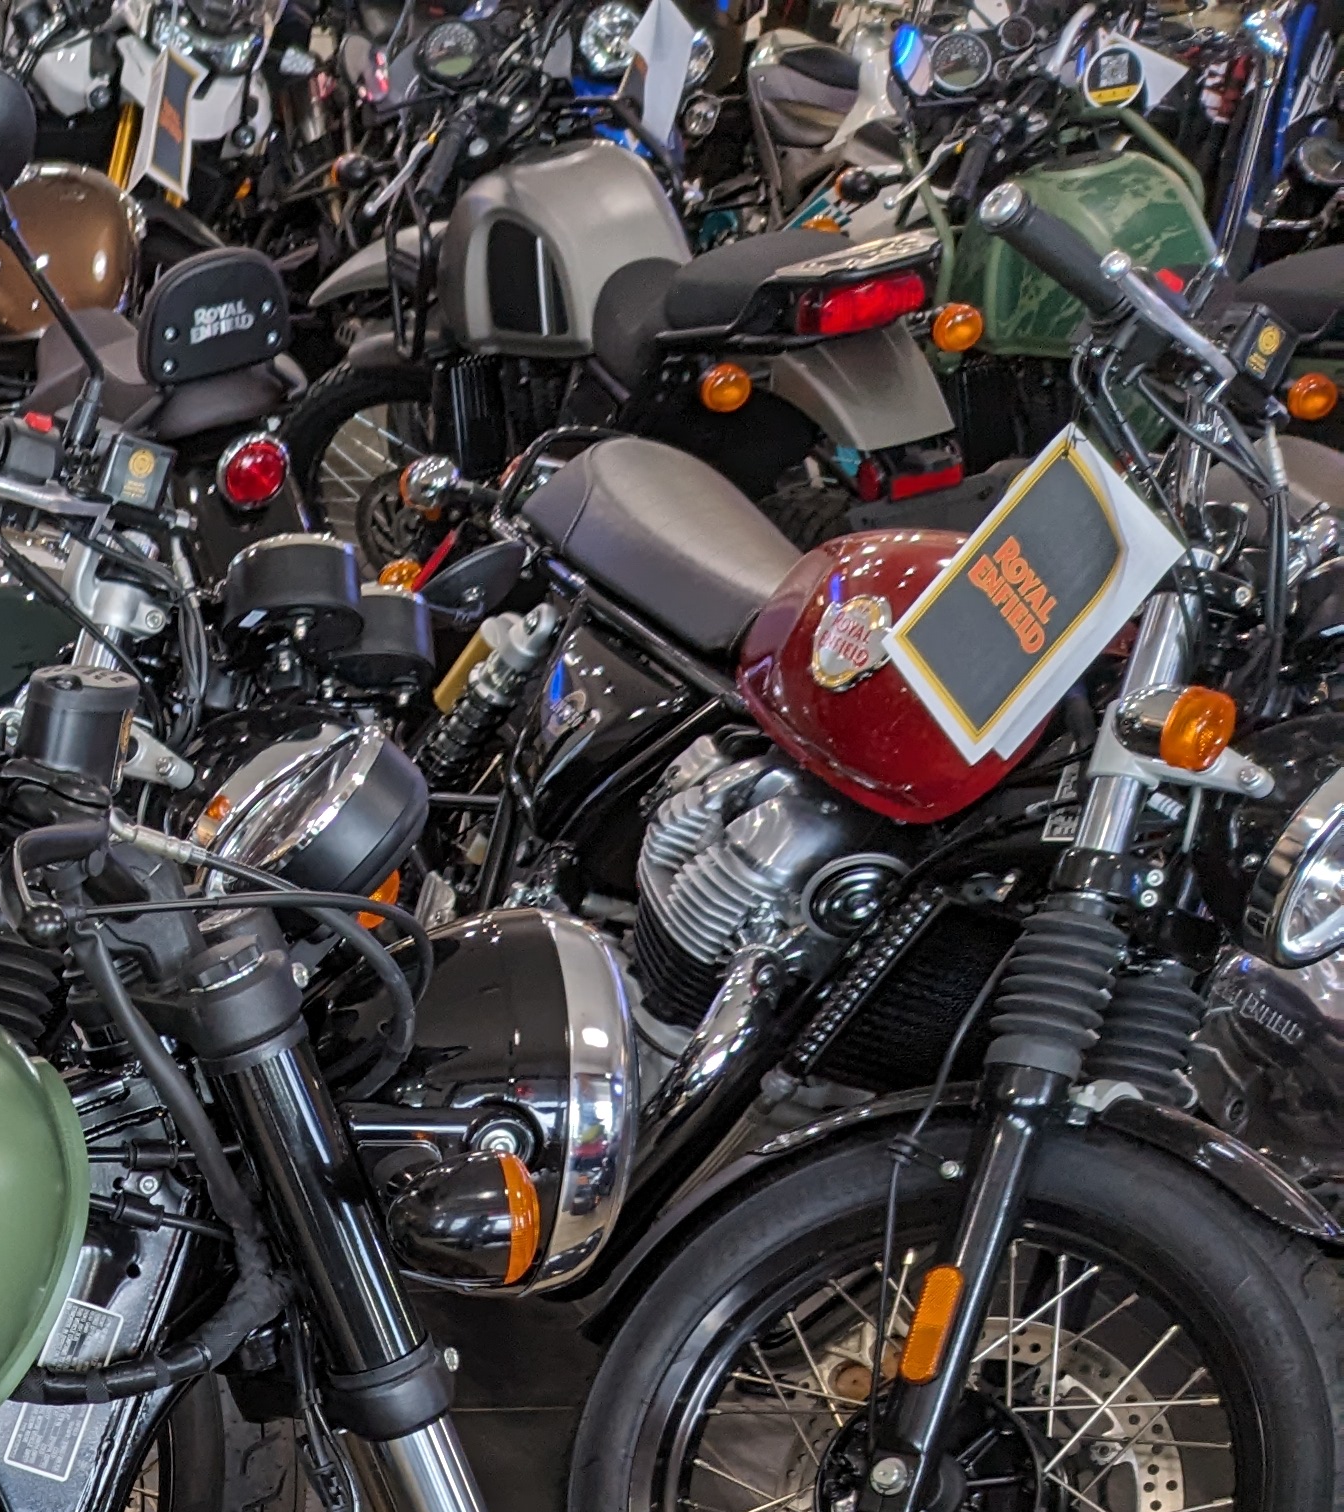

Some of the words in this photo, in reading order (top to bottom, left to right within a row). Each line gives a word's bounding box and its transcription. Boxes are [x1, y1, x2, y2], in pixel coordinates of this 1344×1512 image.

[189, 313, 256, 344] ENFIELD
[193, 299, 247, 326] ROYAL
[993, 535, 1058, 625] ROYAL
[967, 553, 1045, 655] ENFIELD
[833, 611, 872, 645] ROYAL
[819, 628, 870, 667] ENFIELD
